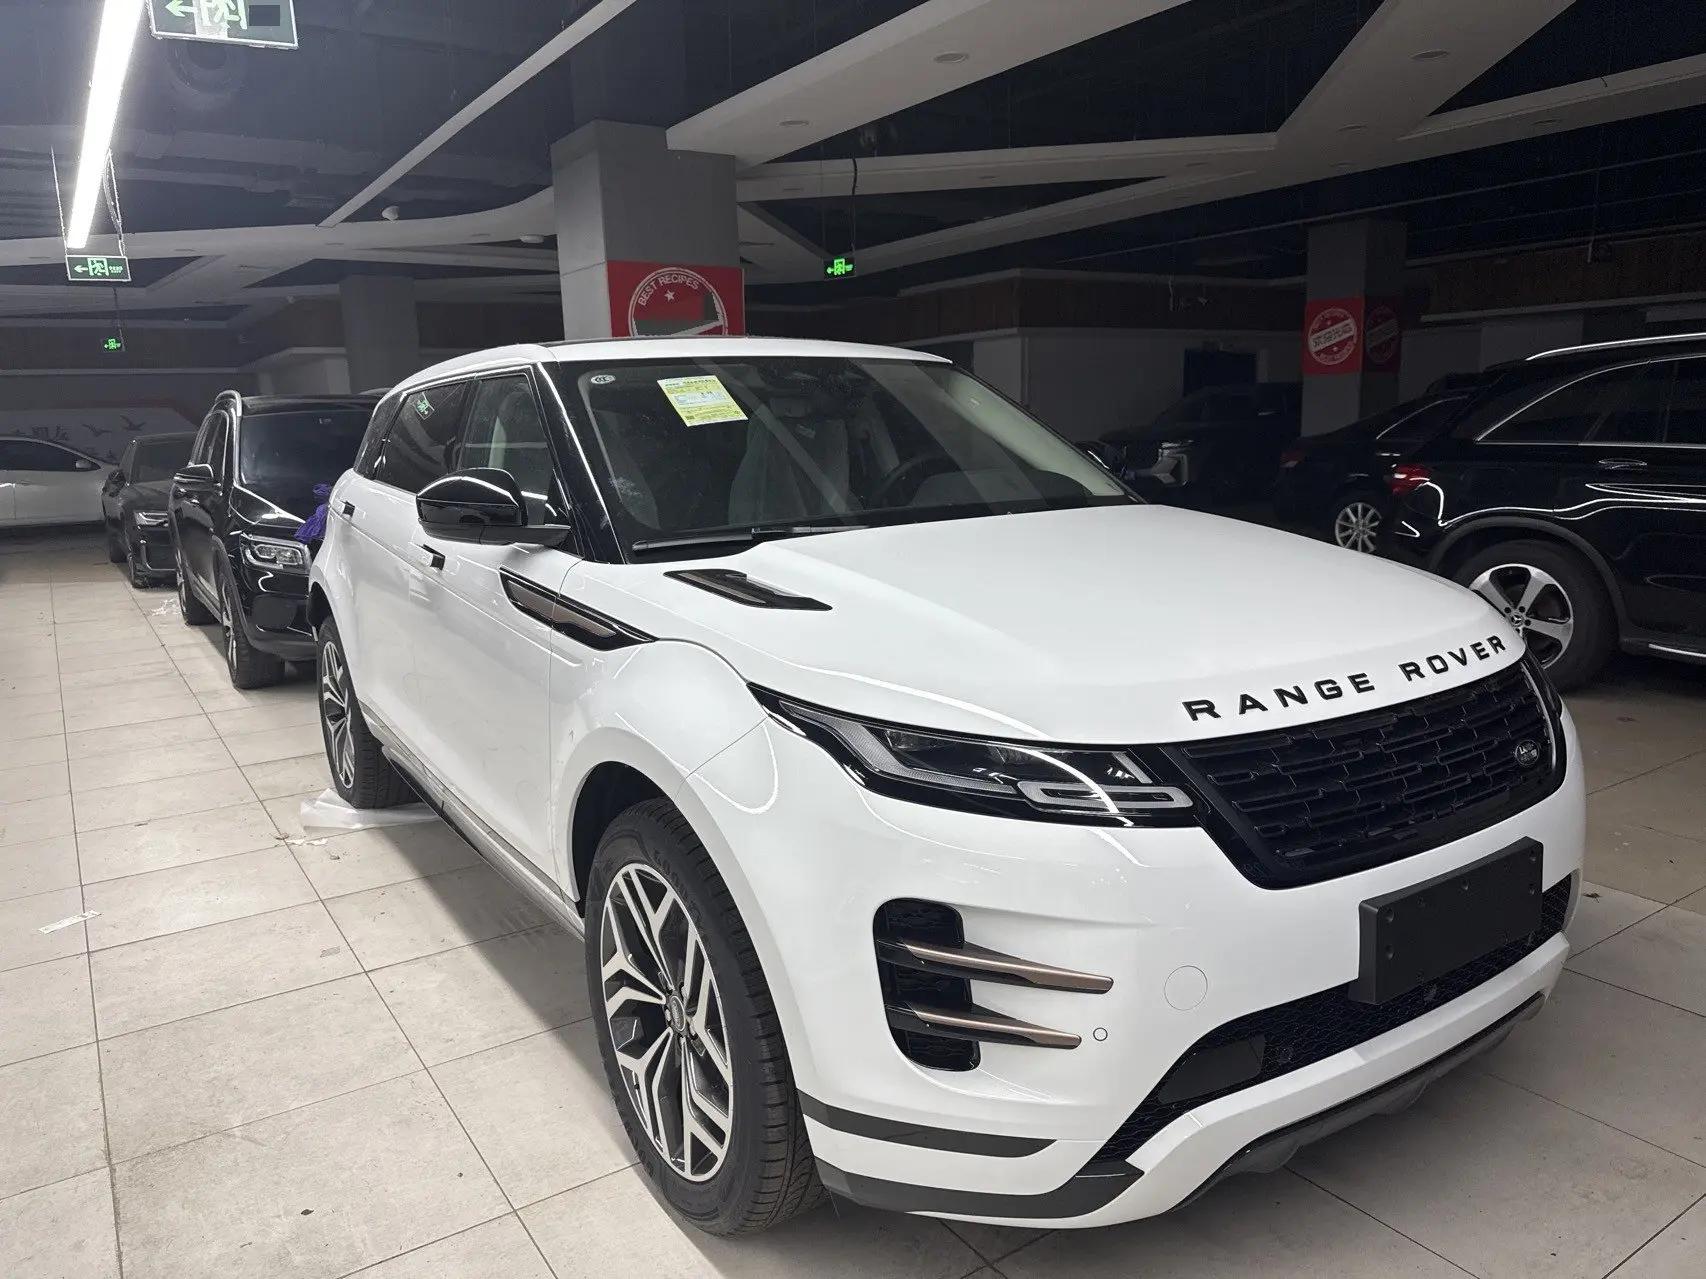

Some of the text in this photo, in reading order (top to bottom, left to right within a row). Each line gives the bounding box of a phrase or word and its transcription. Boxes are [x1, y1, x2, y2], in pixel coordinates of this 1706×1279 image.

[638, 274, 700, 306] BEST RECIPES
[1182, 635, 1507, 722] RANGE ROVER
